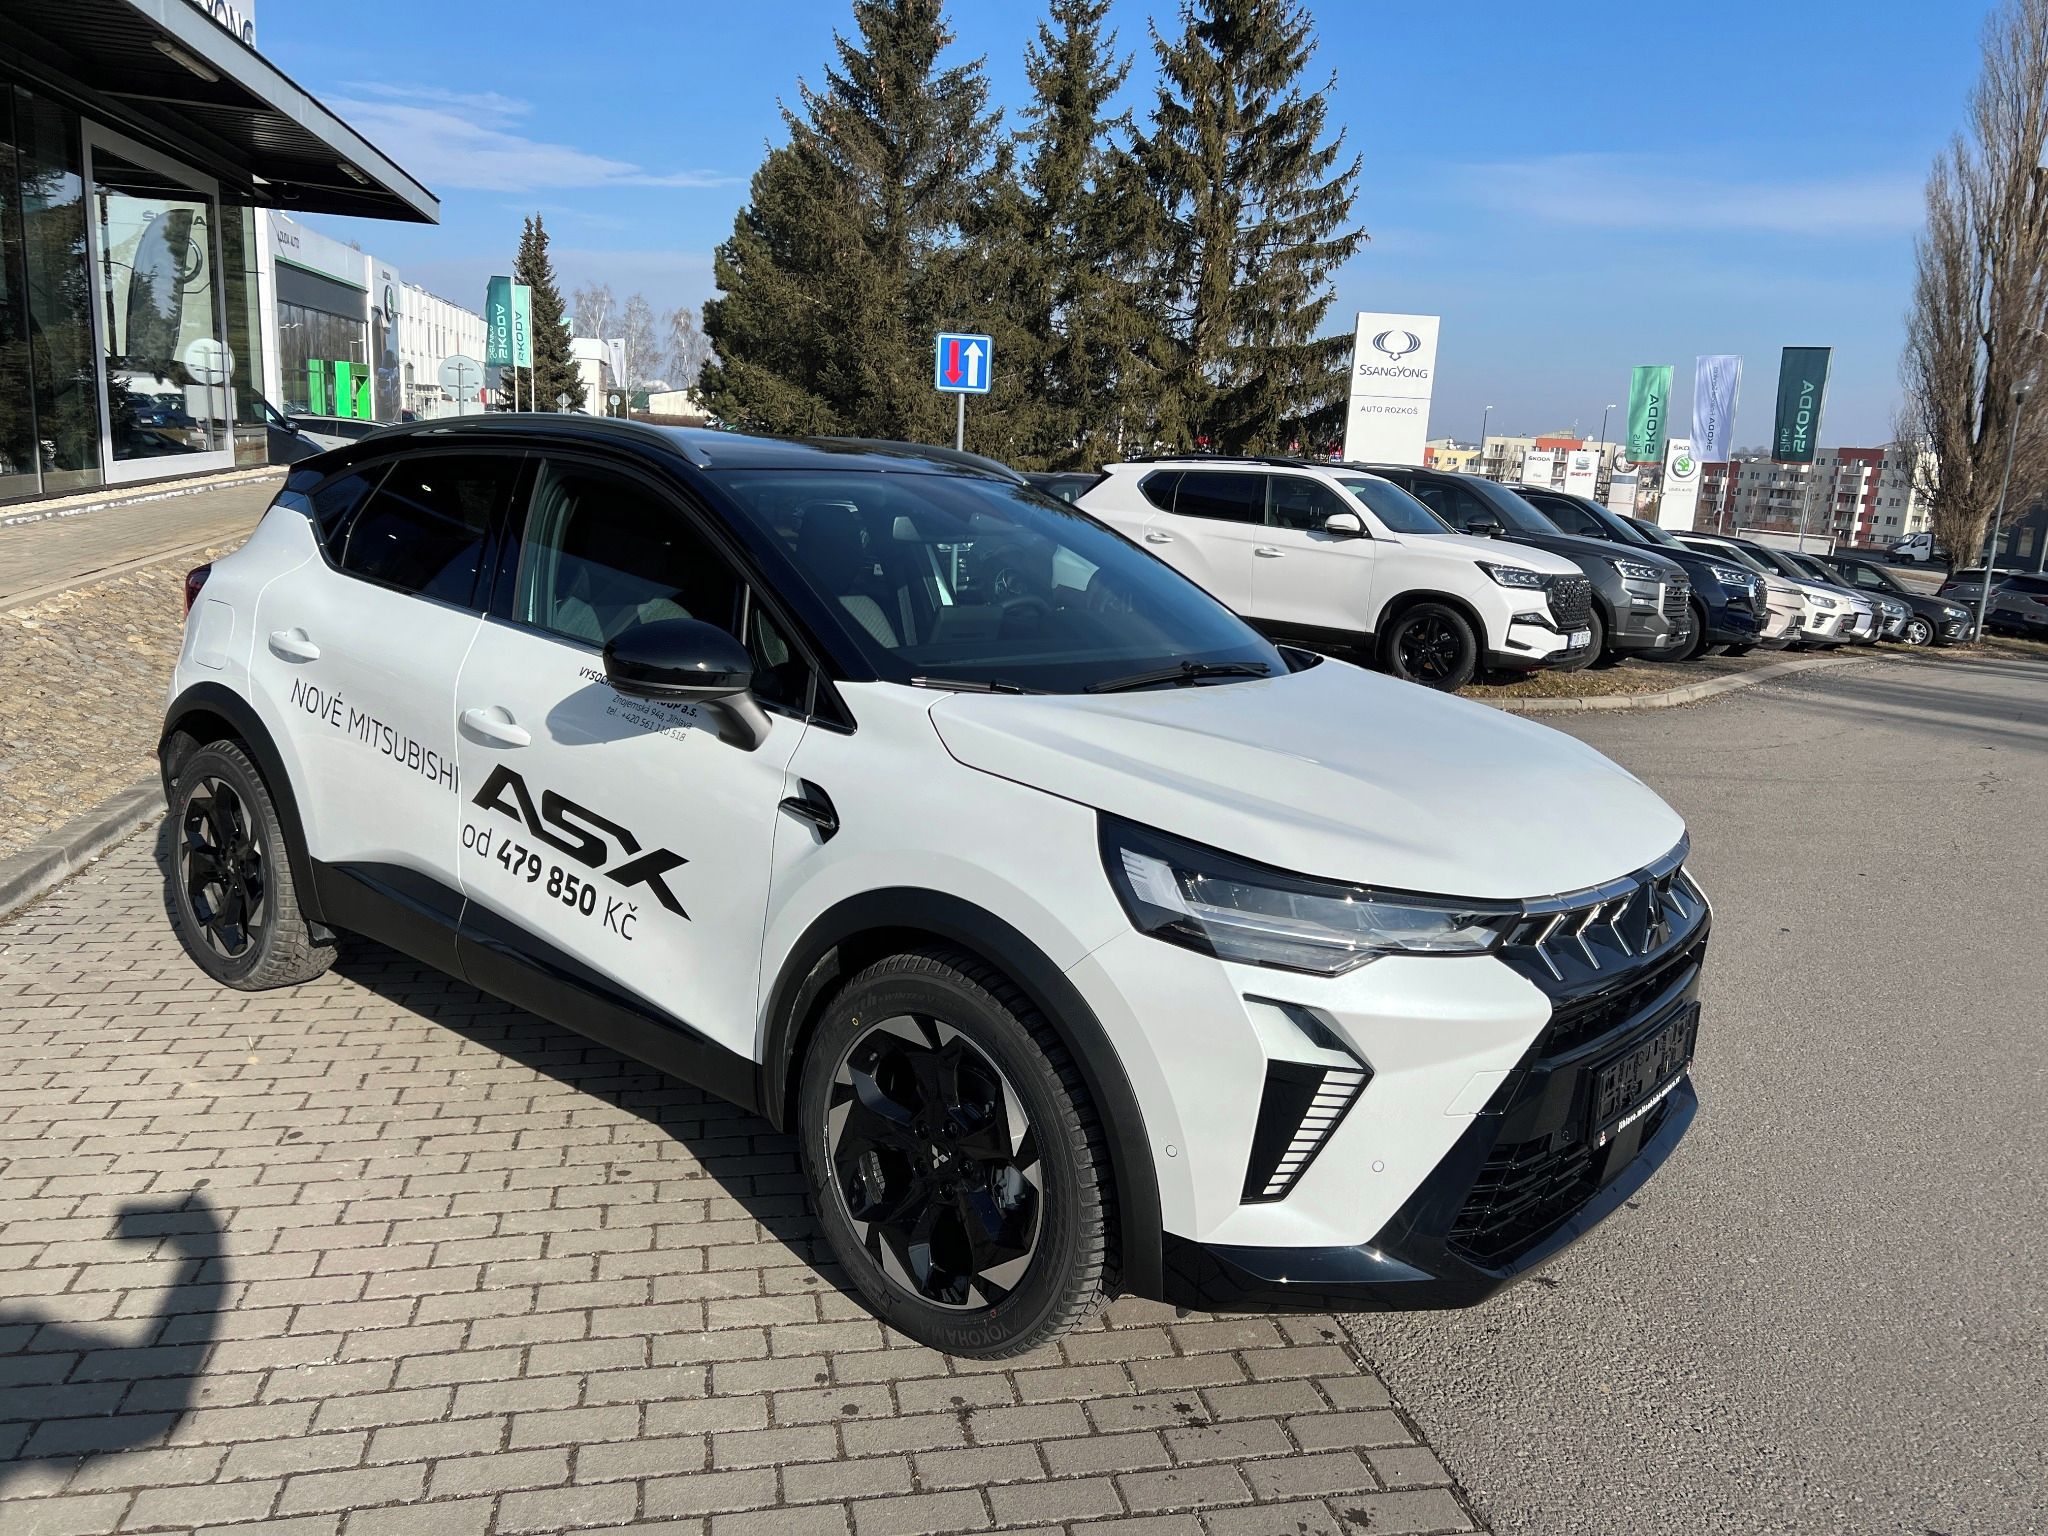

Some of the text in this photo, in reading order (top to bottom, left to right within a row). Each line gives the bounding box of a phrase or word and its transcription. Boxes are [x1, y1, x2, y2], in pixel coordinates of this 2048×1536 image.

[1360, 405, 1419, 415] AUTO ROZKOŠ
[290, 677, 460, 794] NOVÉ MITSUBISHI
[612, 694, 651, 714] Znojemská
[666, 714, 693, 729] Jihlava
[621, 712, 640, 724] +420
[640, 718, 655, 730] 561
[655, 723, 671, 736] 110
[670, 729, 687, 742] 518
[462, 823, 493, 858] od
[496, 838, 543, 883] 479
[546, 864, 597, 917] 850
[471, 763, 692, 922] ASX
